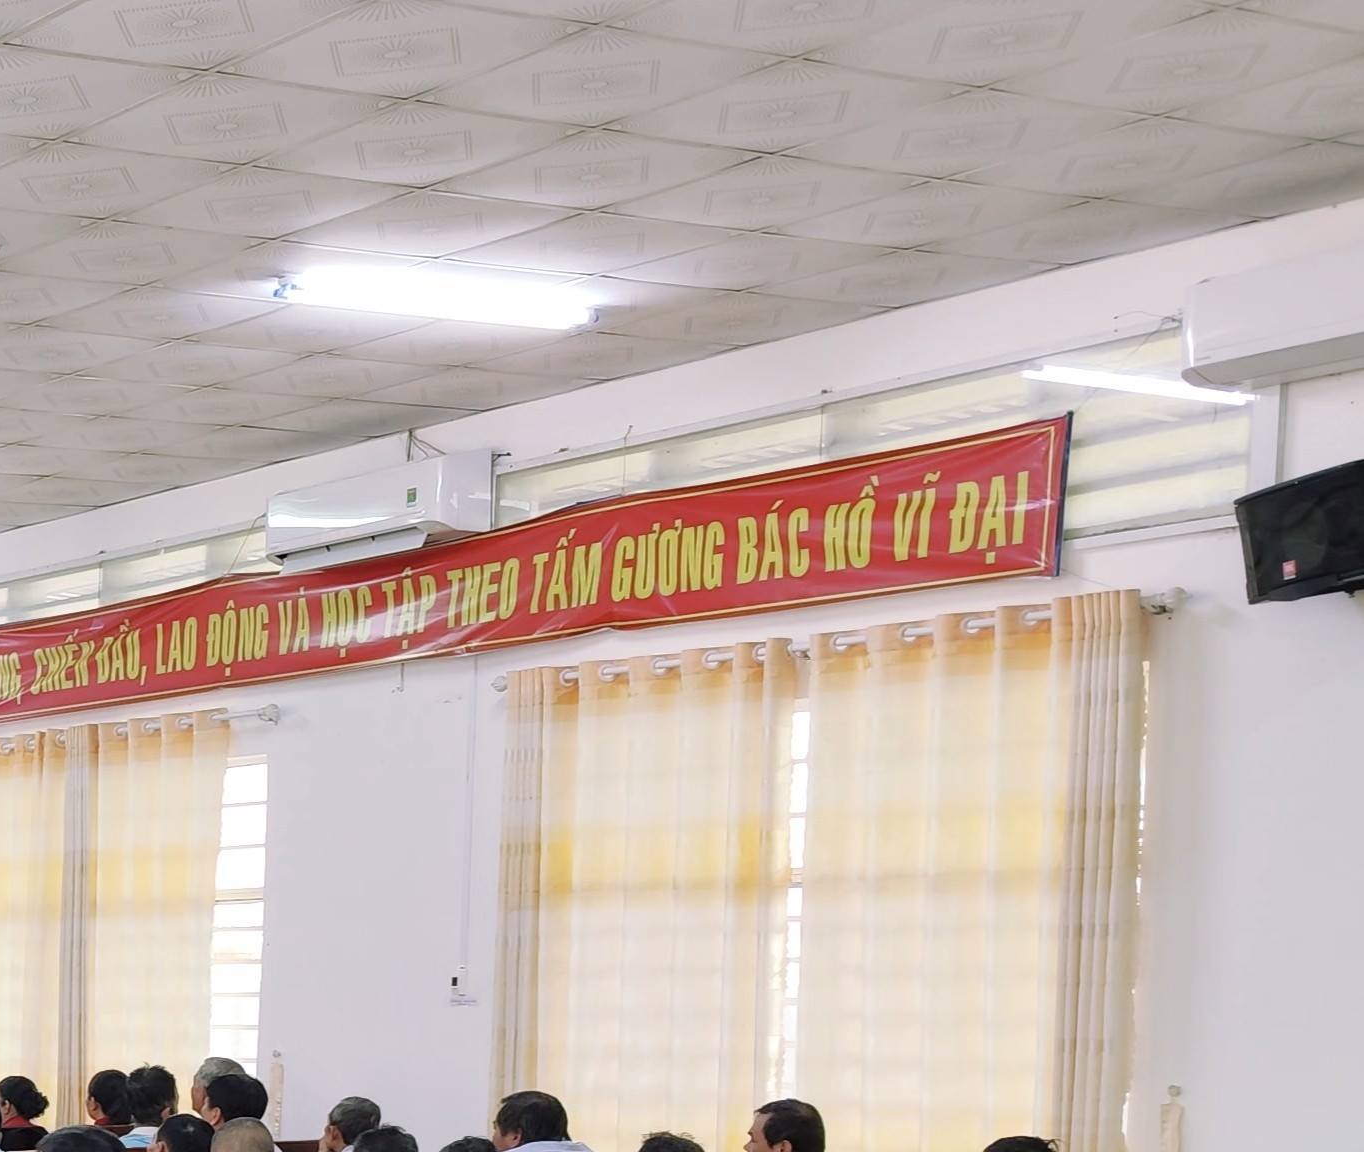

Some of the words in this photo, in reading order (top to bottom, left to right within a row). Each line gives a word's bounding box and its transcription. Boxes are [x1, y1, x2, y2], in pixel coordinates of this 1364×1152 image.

[30, 629, 95, 695] CHIẾN
[156, 617, 197, 674] LAO
[206, 600, 270, 677] ĐỘNG
[278, 586, 310, 655] VÀ
[320, 586, 373, 658] HỌC
[381, 567, 437, 650] TẬP
[446, 558, 520, 628] THEO
[530, 527, 605, 614] TẤM
[612, 517, 725, 603] GƯƠNG
[737, 498, 809, 584] BÁC
[825, 475, 879, 573] HỒ
[893, 471, 942, 562] VĨ
[949, 471, 1030, 565] ĐẠI
